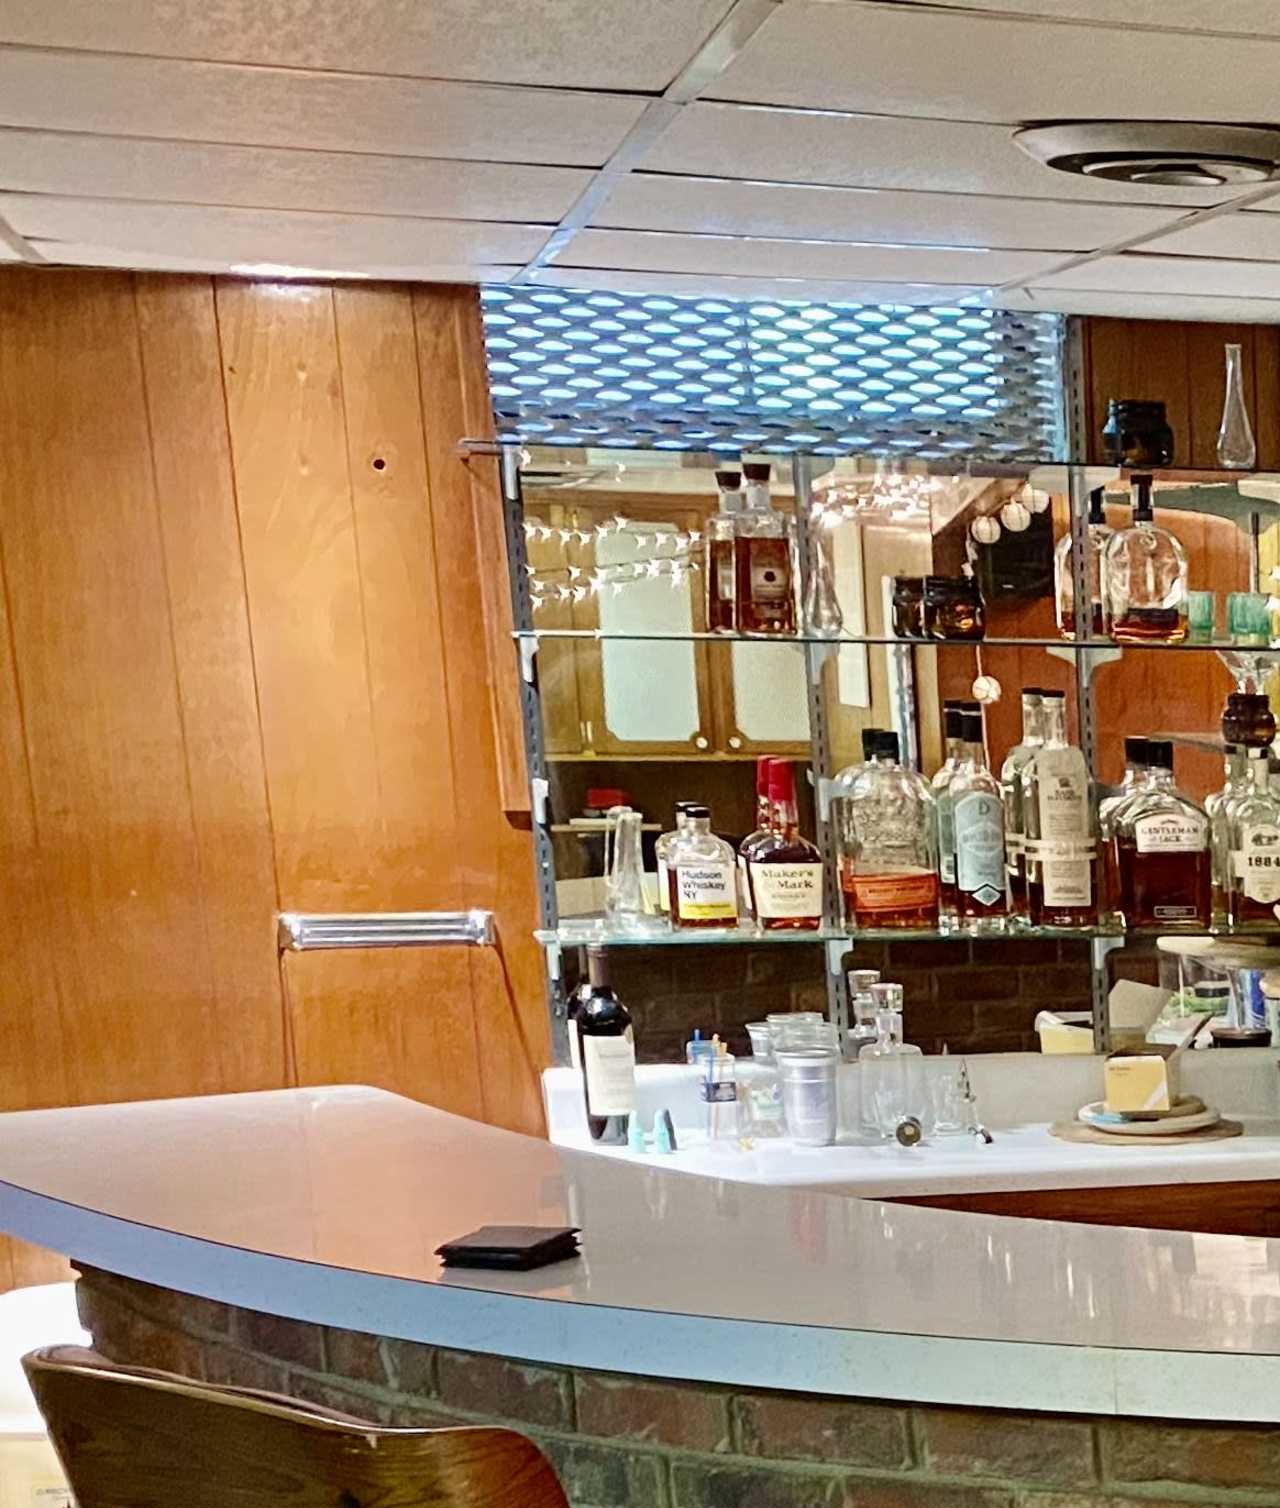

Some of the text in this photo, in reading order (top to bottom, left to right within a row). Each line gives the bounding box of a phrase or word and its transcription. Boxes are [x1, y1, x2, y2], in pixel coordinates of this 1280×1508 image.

[1141, 826, 1199, 835] GENTLEMAN
[682, 870, 722, 879] Hudson
[682, 880, 726, 891] Whiskey
[777, 880, 815, 889] Mark
